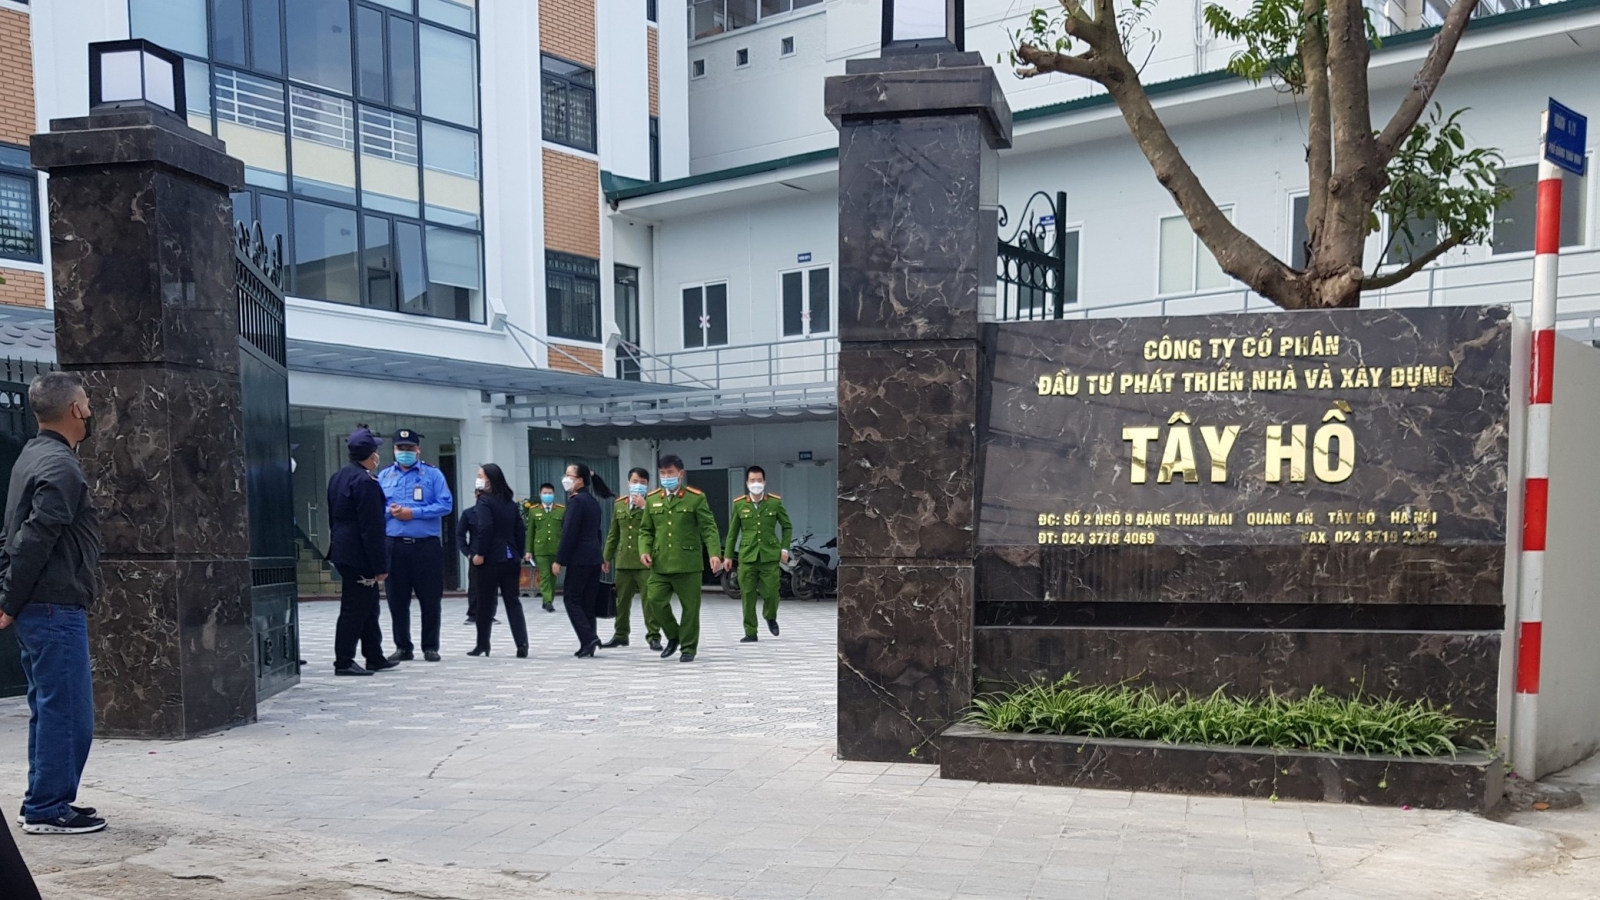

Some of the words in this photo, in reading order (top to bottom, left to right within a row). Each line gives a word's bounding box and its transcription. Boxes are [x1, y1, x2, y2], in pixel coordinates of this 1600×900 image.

[1144, 335, 1201, 360] CÔNG
[1209, 338, 1236, 359] TY
[1242, 328, 1273, 359] CỔ
[1037, 370, 1080, 396] ĐẦU
[1086, 372, 1115, 395] TƯ
[1120, 369, 1175, 394] PHÁT
[1182, 362, 1244, 393] TRIỂN
[1252, 364, 1297, 391] NHÀ
[1304, 363, 1334, 389] VÀ
[1391, 363, 1454, 393] DỰNG
[1122, 411, 1241, 484] TÂY
[1064, 509, 1081, 526] SỐ
[1084, 513, 1092, 526] 2
[1095, 511, 1122, 526] NGÕ
[1124, 513, 1133, 526] 9
[1136, 511, 1171, 528] ĐẶNG
[1207, 512, 1233, 525] MAI
[1246, 508, 1292, 526] QUẢNG
[1295, 512, 1315, 525] AN
[1037, 532, 1058, 545] ĐT:
[1061, 532, 1085, 545] 024
[1088, 532, 1119, 545] 3718
[1123, 532, 1156, 545] 4069
[1333, 530, 1361, 544] 024
